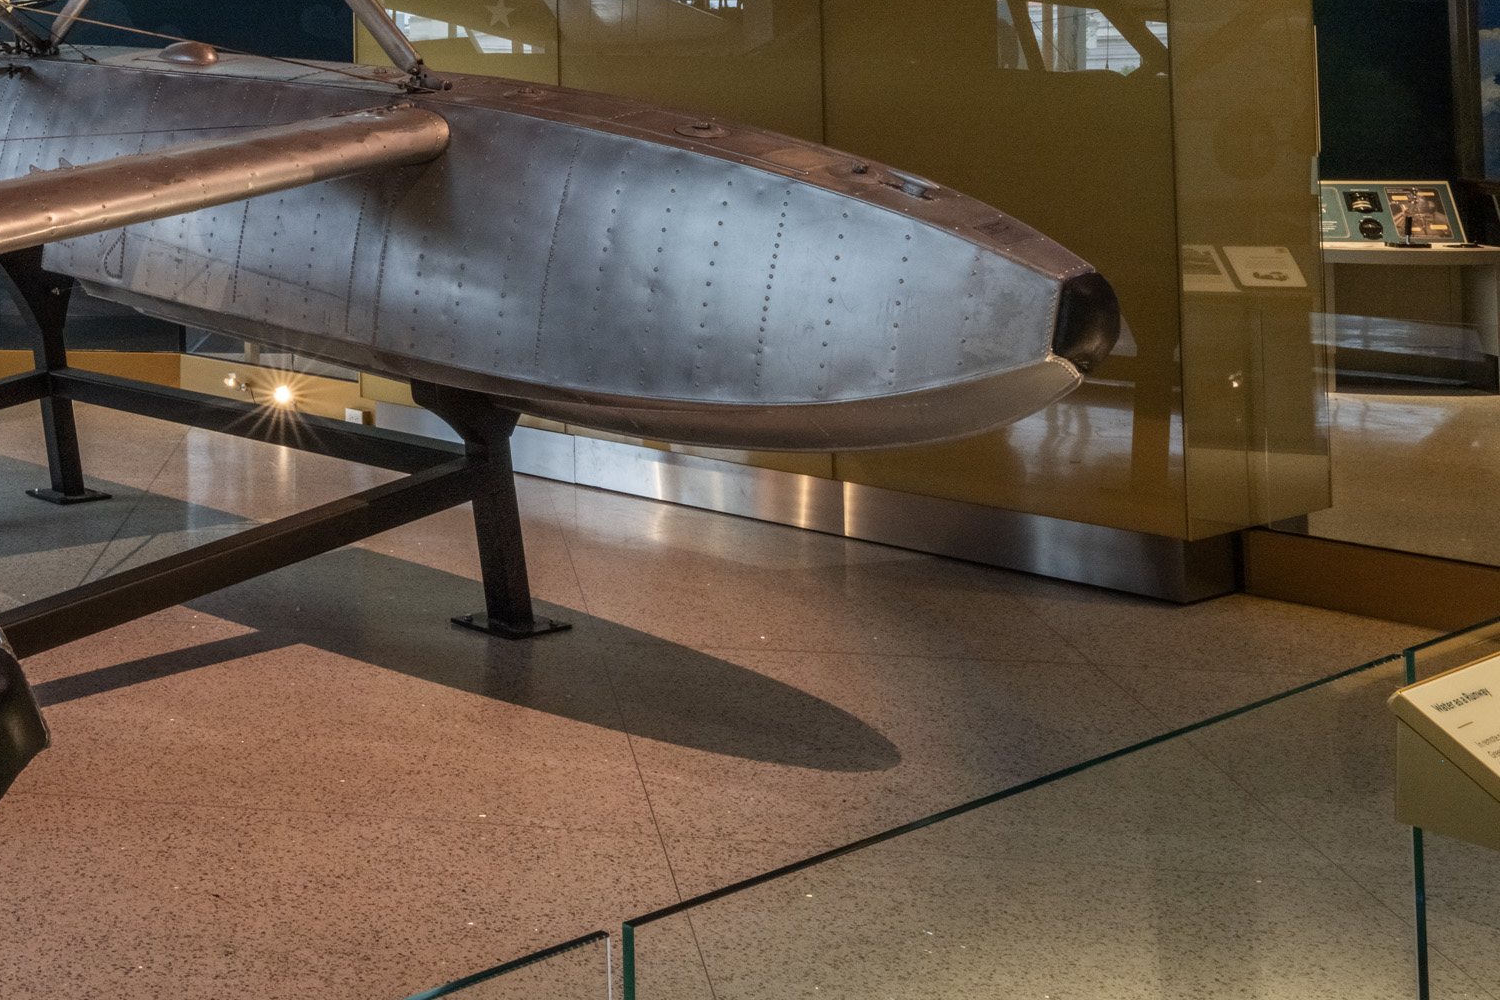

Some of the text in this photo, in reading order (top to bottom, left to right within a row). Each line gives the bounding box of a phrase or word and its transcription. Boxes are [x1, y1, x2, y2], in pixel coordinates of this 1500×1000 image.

[1430, 701, 1456, 713] Water
[1452, 698, 1464, 707] as
[1462, 688, 1492, 701] Runway
